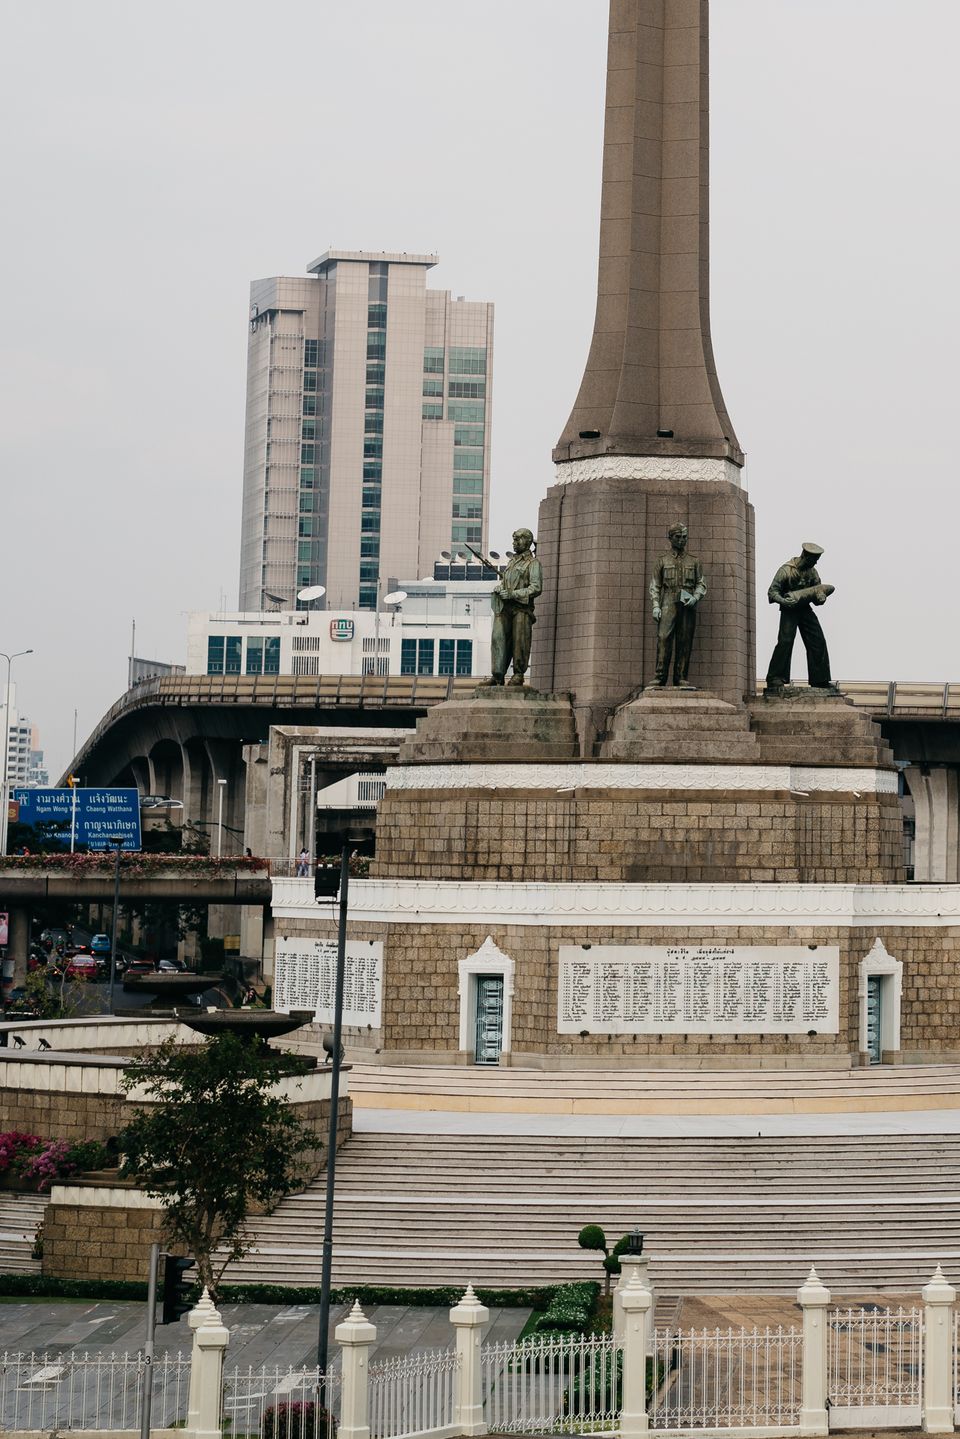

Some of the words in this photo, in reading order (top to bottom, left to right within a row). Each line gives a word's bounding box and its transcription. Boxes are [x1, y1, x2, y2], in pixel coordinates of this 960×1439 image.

[89, 793, 128, 803] แจ้งวัฒนะ
[84, 819, 137, 831] กาญจนาภิเษก
[145, 1355, 151, 1365] 3
